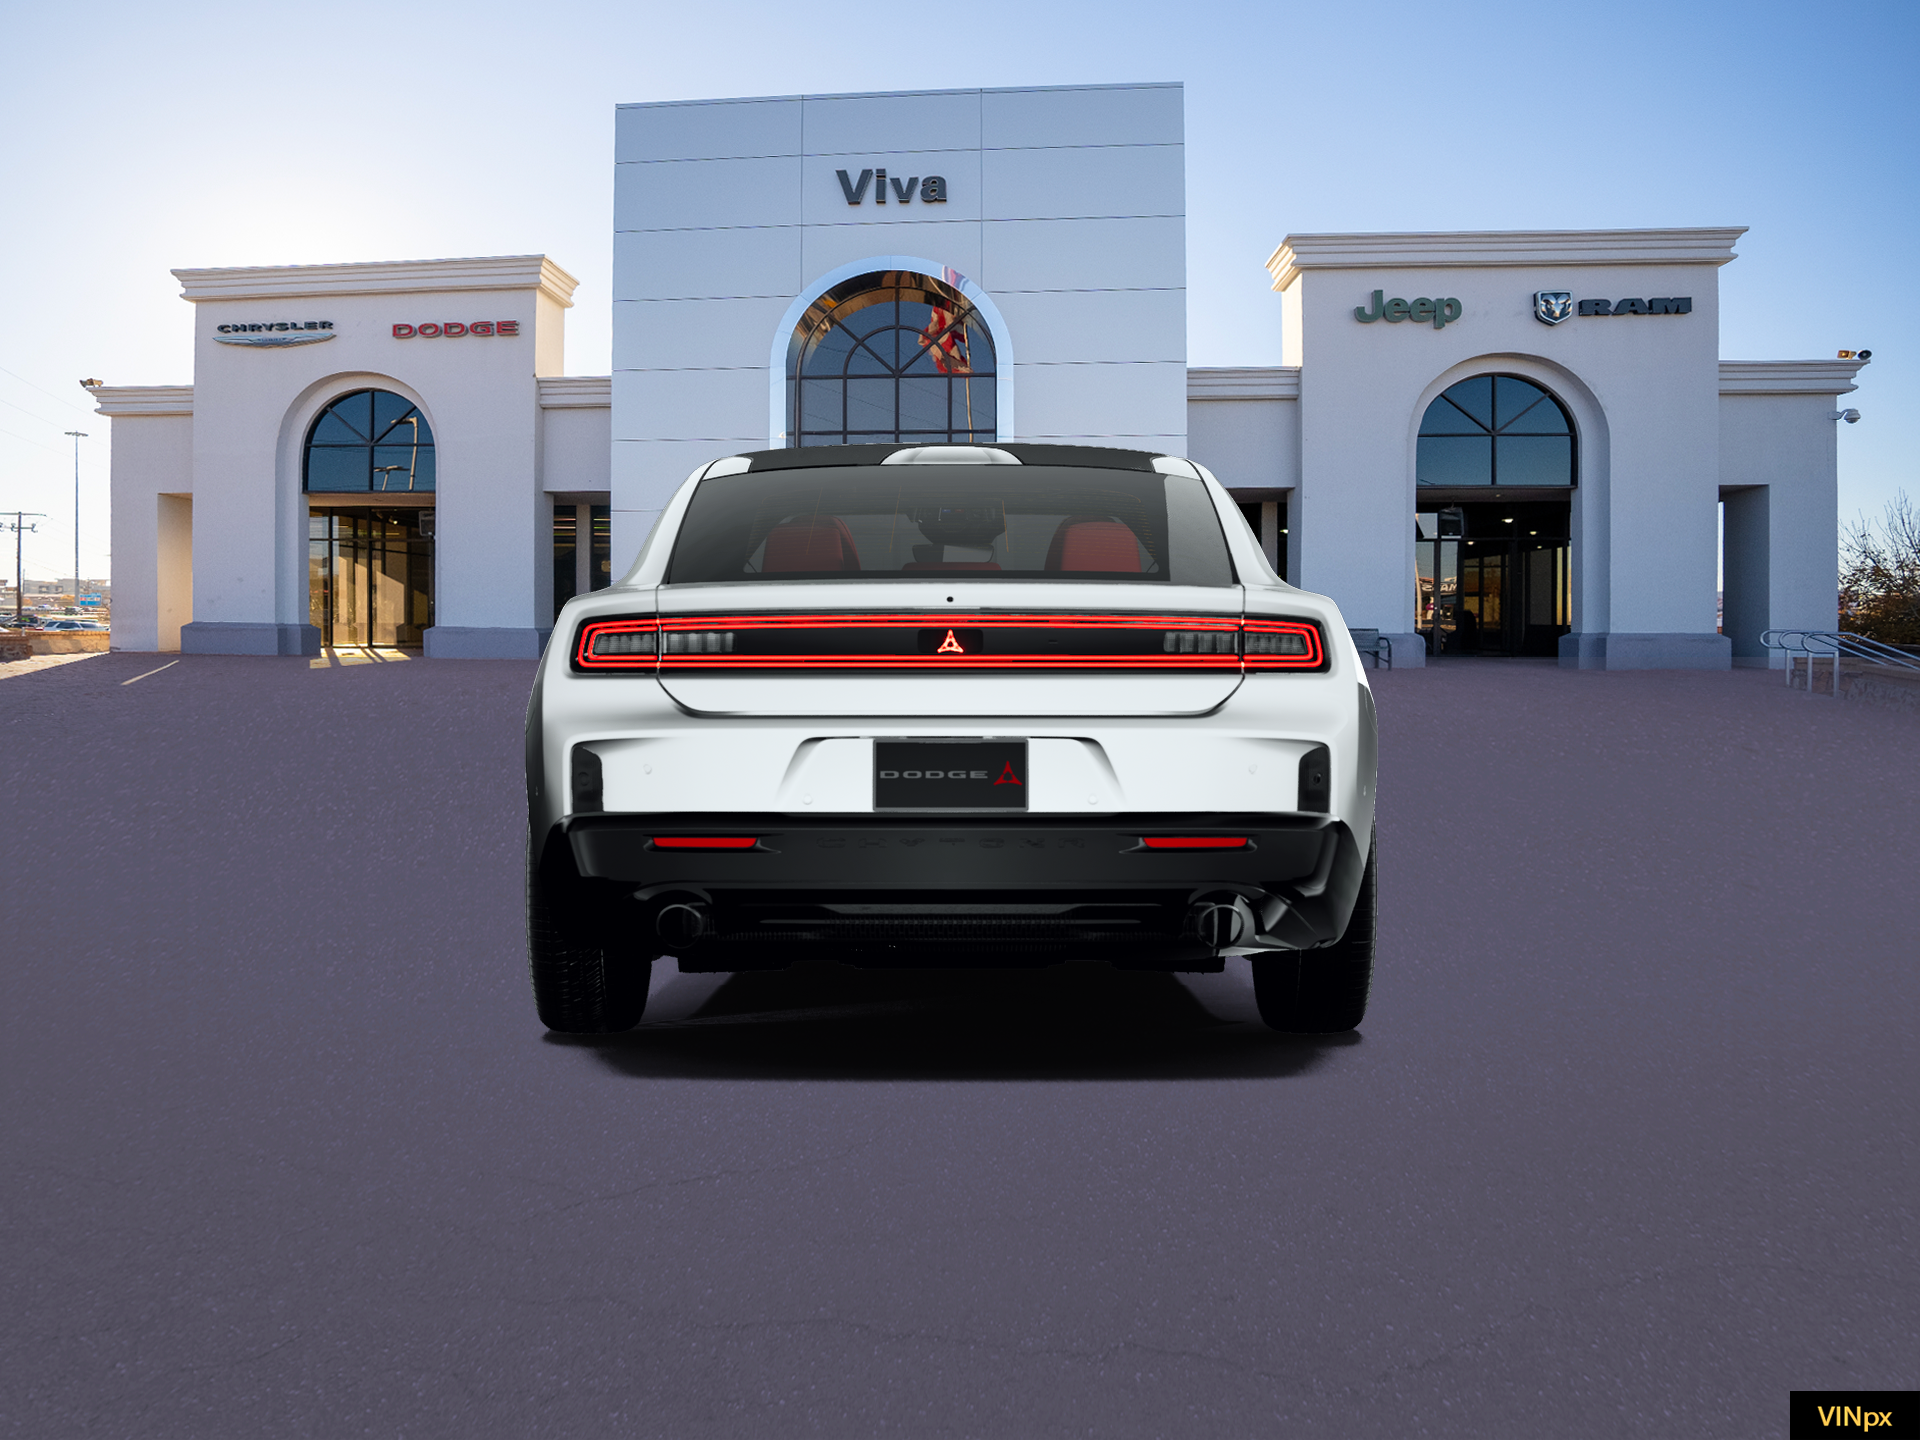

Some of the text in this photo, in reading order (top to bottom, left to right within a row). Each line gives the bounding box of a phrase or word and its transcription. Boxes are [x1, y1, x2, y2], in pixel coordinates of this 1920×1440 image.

[835, 168, 947, 205] Viva
[1354, 289, 1463, 330] Jeep
[1578, 297, 1692, 317] RAM
[217, 321, 334, 334] CHRYSLER
[392, 319, 520, 339] DODGE
[879, 770, 989, 779] DODGE
